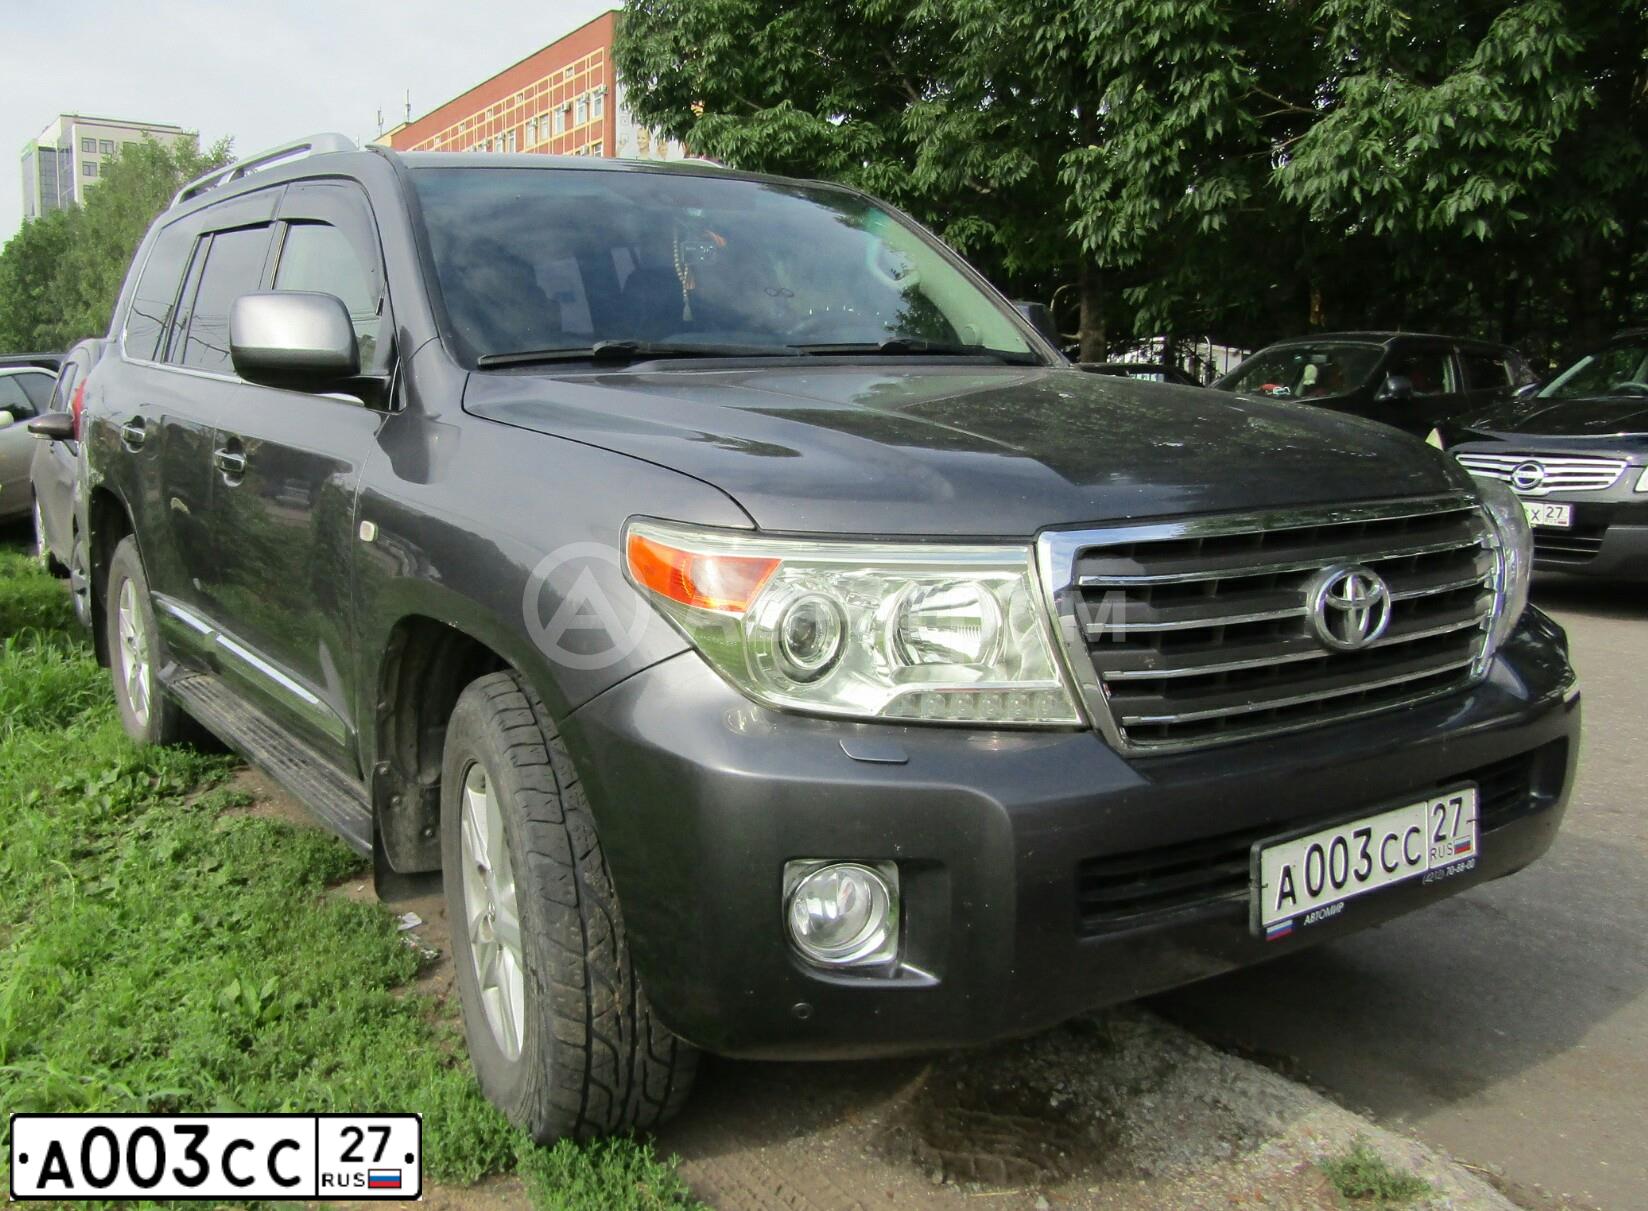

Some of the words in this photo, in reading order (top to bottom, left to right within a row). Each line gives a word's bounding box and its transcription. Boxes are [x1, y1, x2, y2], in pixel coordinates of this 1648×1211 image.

[1546, 506, 1564, 519] 27
[1430, 796, 1463, 844] 27
[1430, 842, 1454, 861] RUS
